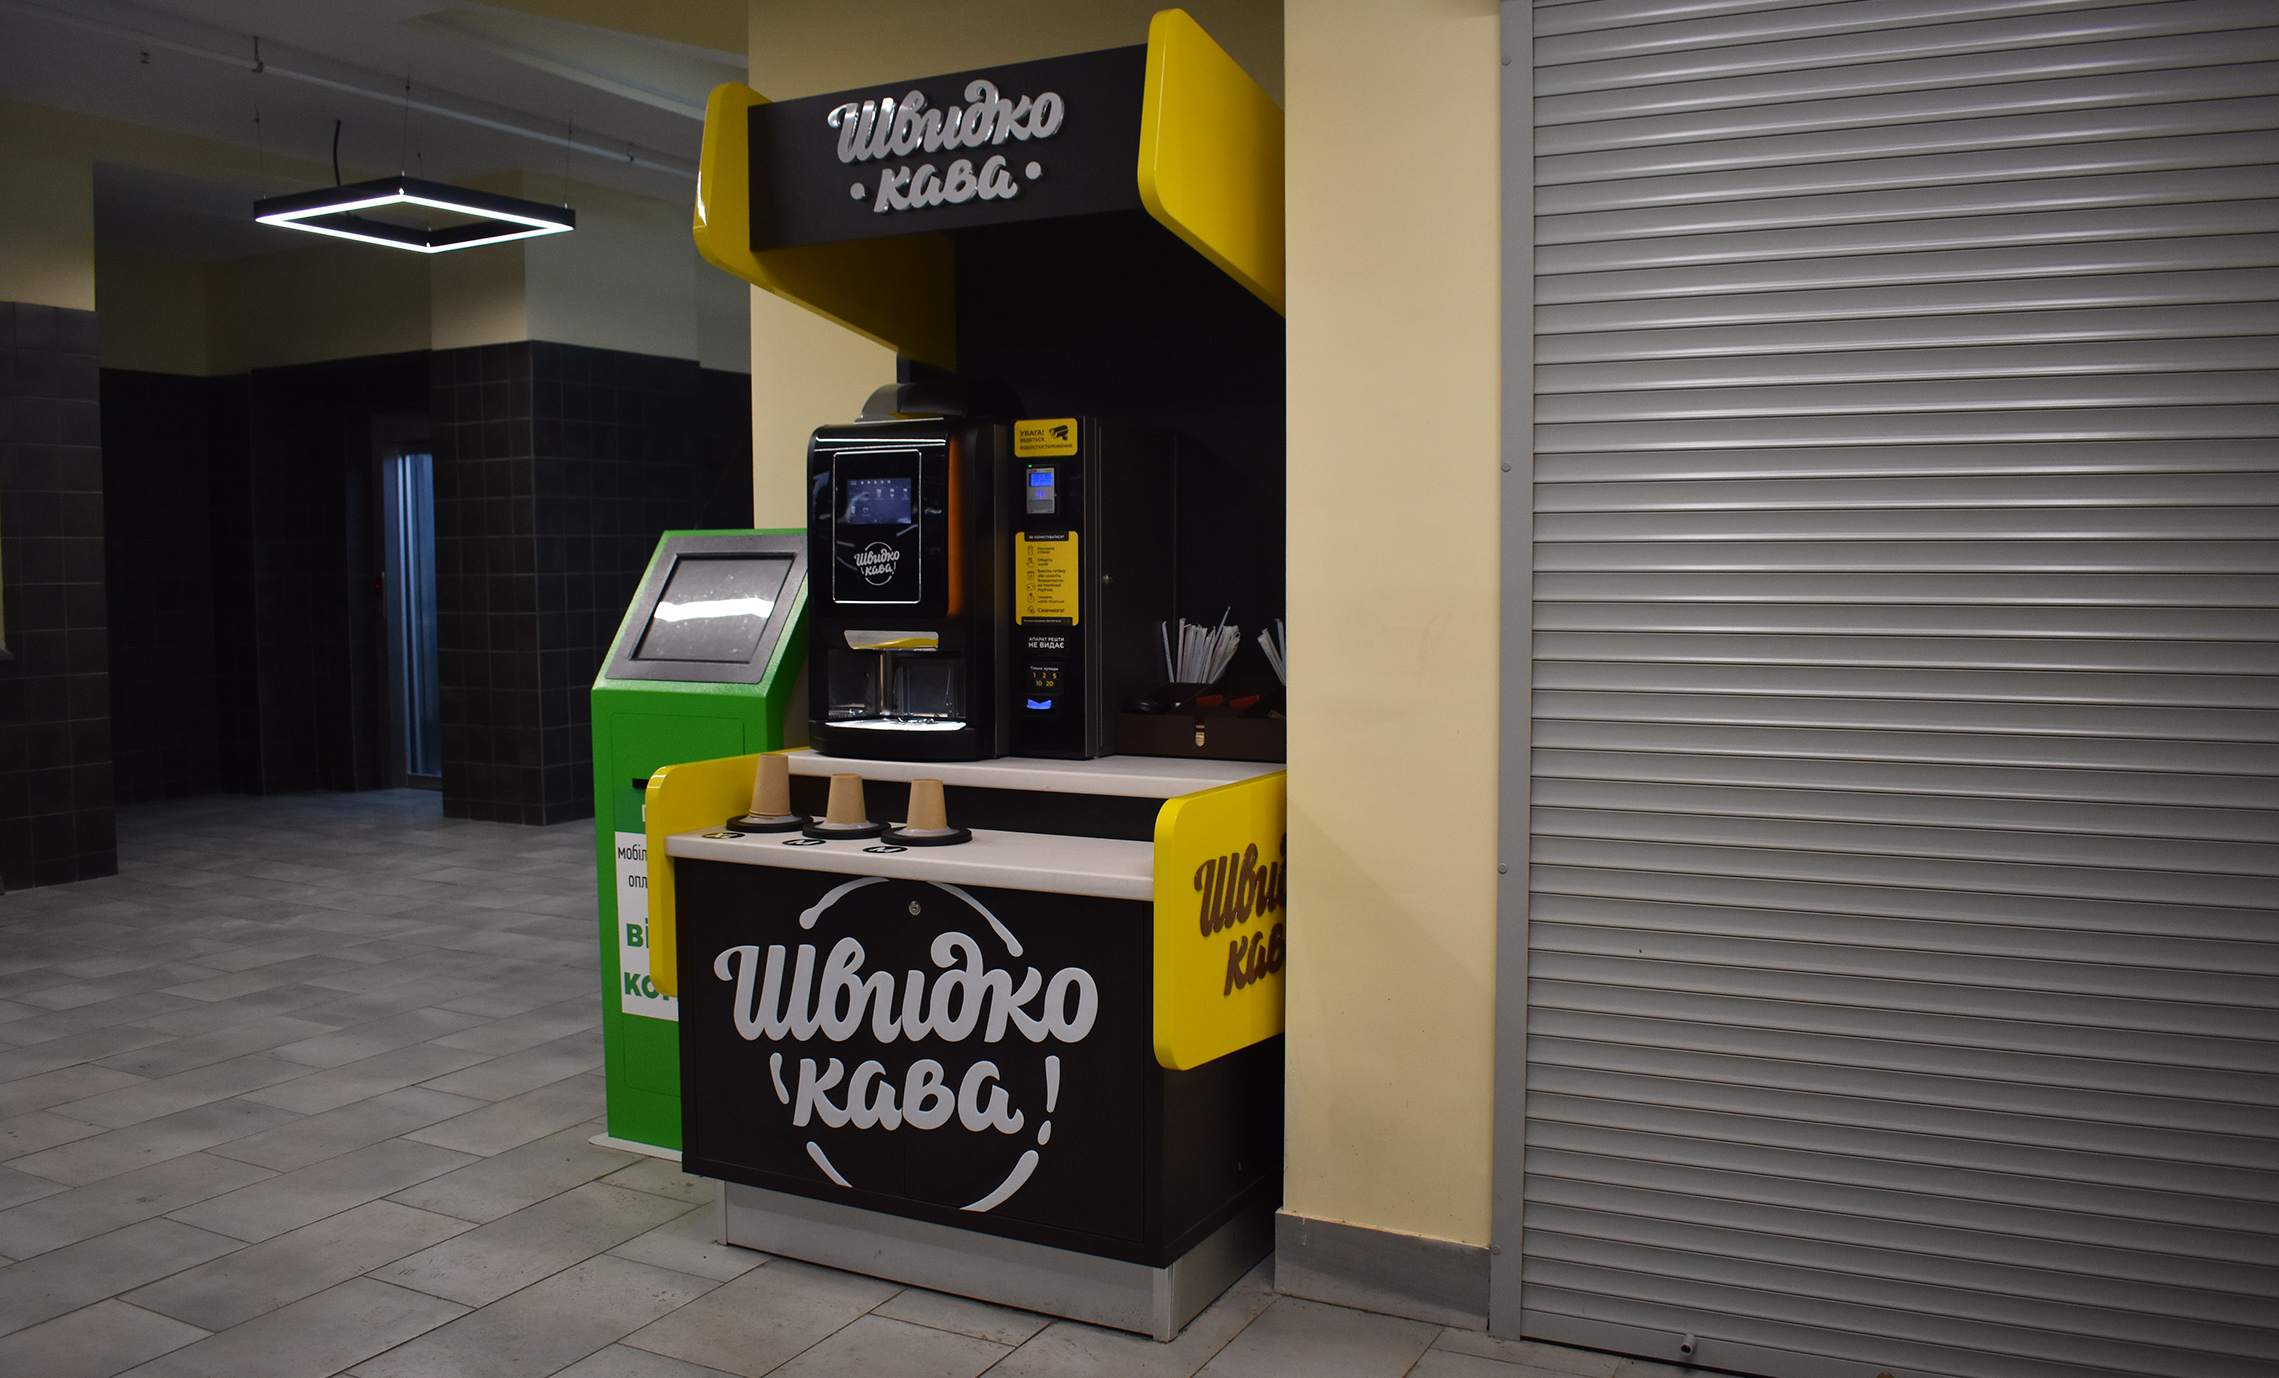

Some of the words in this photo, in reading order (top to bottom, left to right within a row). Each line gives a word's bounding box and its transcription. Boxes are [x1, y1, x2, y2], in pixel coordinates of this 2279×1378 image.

[827, 79, 1066, 163] Швидко
[873, 155, 1019, 213] кава
[854, 548, 900, 567] Швидко
[714, 931, 1099, 1044] Швидко
